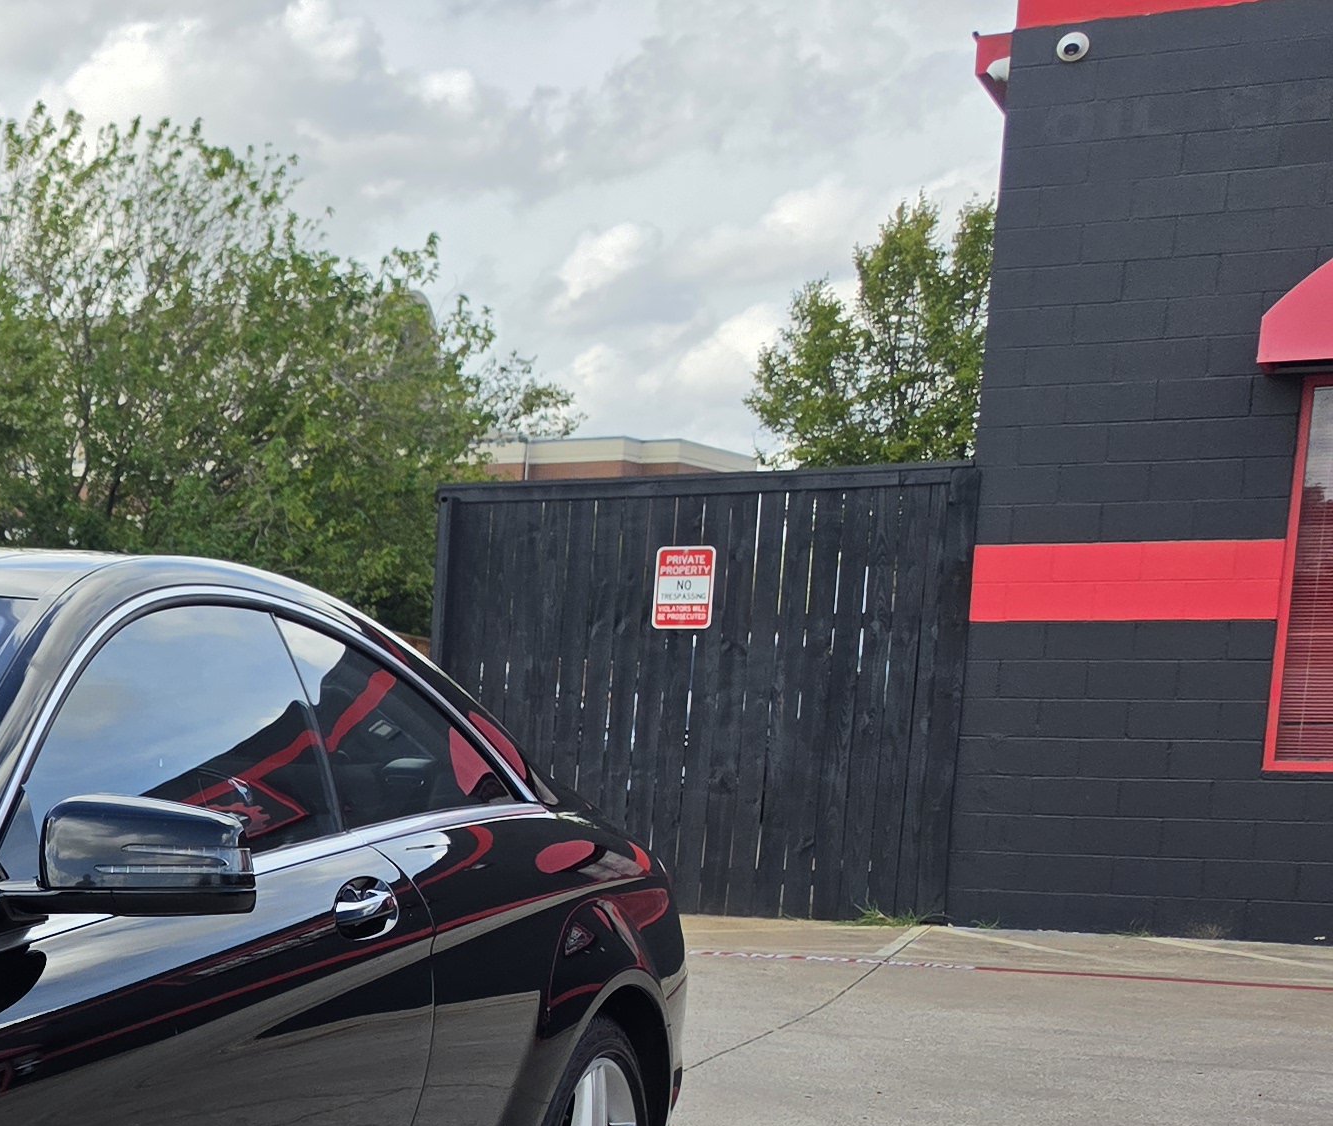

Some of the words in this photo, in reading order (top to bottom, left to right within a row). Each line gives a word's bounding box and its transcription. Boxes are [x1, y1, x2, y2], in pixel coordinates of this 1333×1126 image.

[666, 555, 706, 564] PRIVATE
[660, 565, 711, 575] PROPERTY
[676, 580, 692, 590] NO
